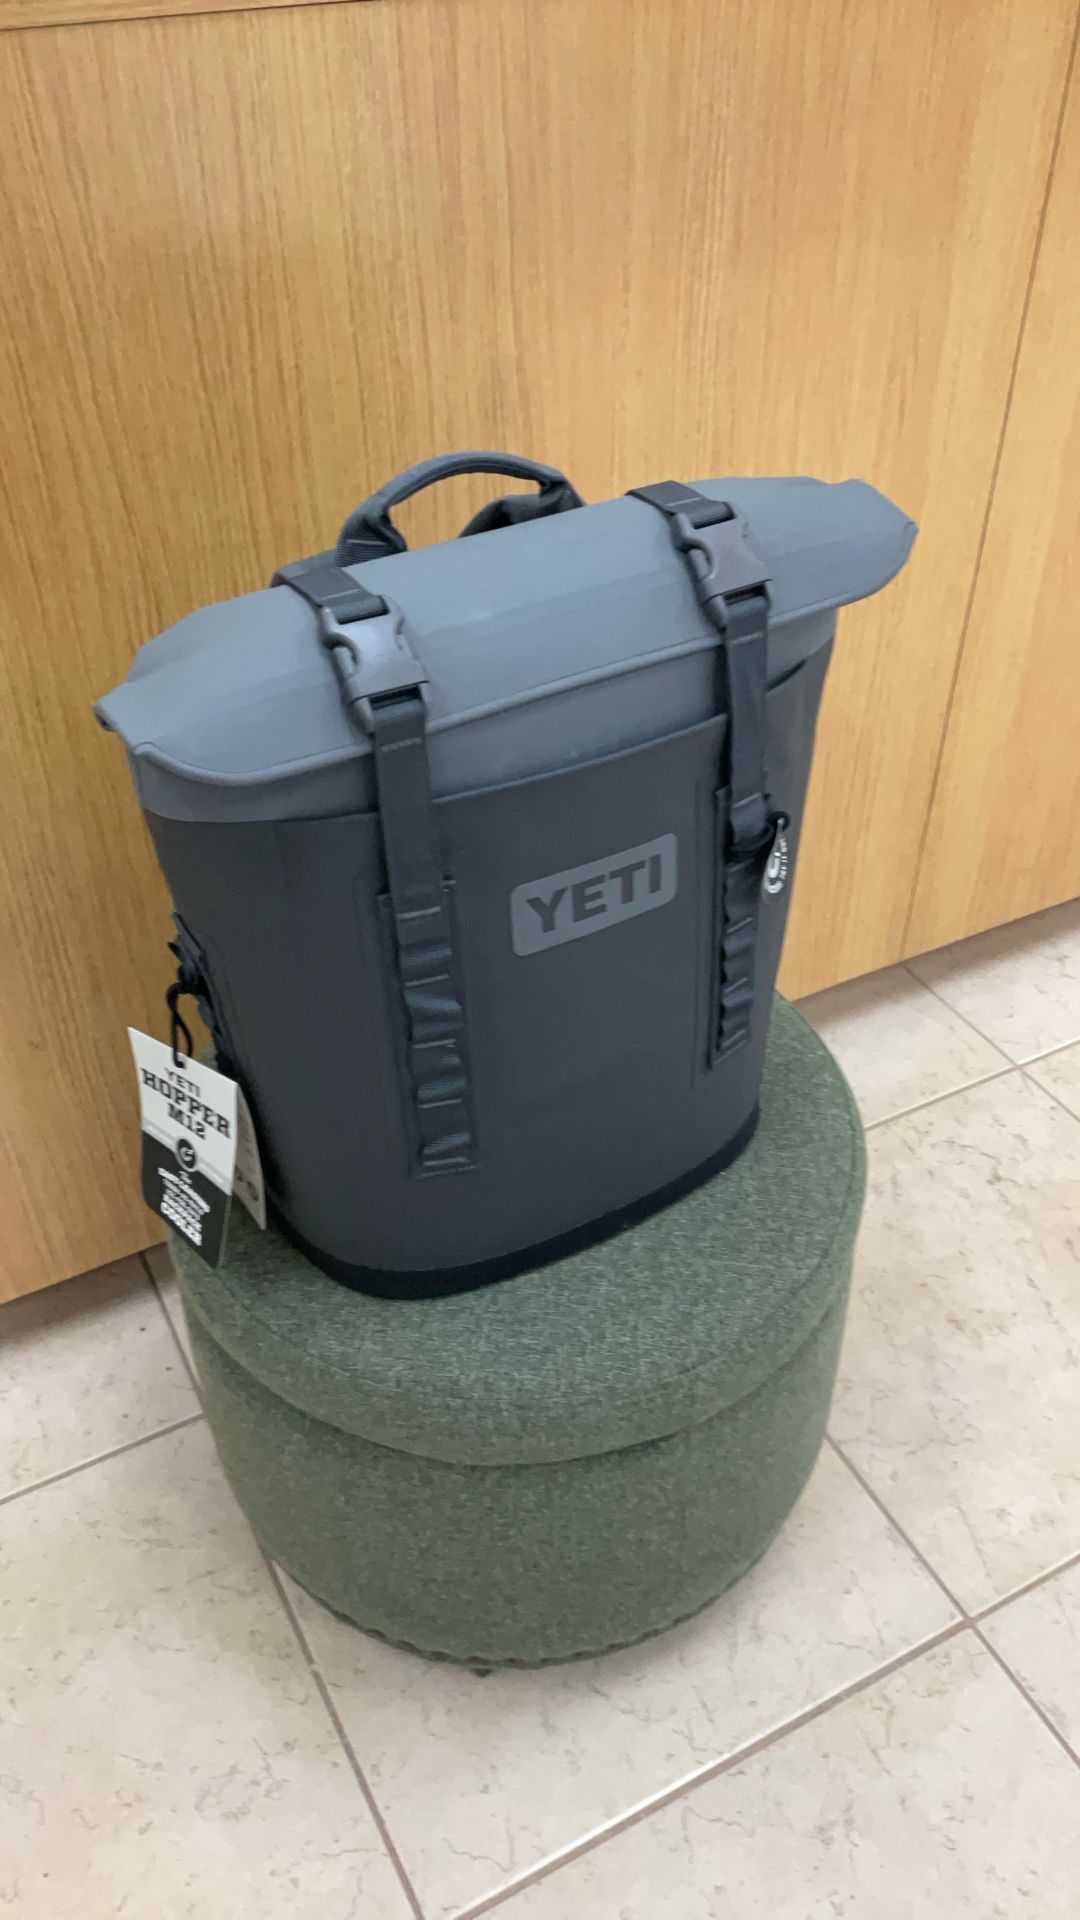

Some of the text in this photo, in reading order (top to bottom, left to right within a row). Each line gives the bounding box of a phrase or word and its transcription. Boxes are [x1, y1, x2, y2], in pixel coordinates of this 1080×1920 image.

[526, 854, 662, 934] YETI
[141, 1068, 232, 1139] HOPPER
[164, 1067, 201, 1098] YETI
[168, 1102, 206, 1140] M12
